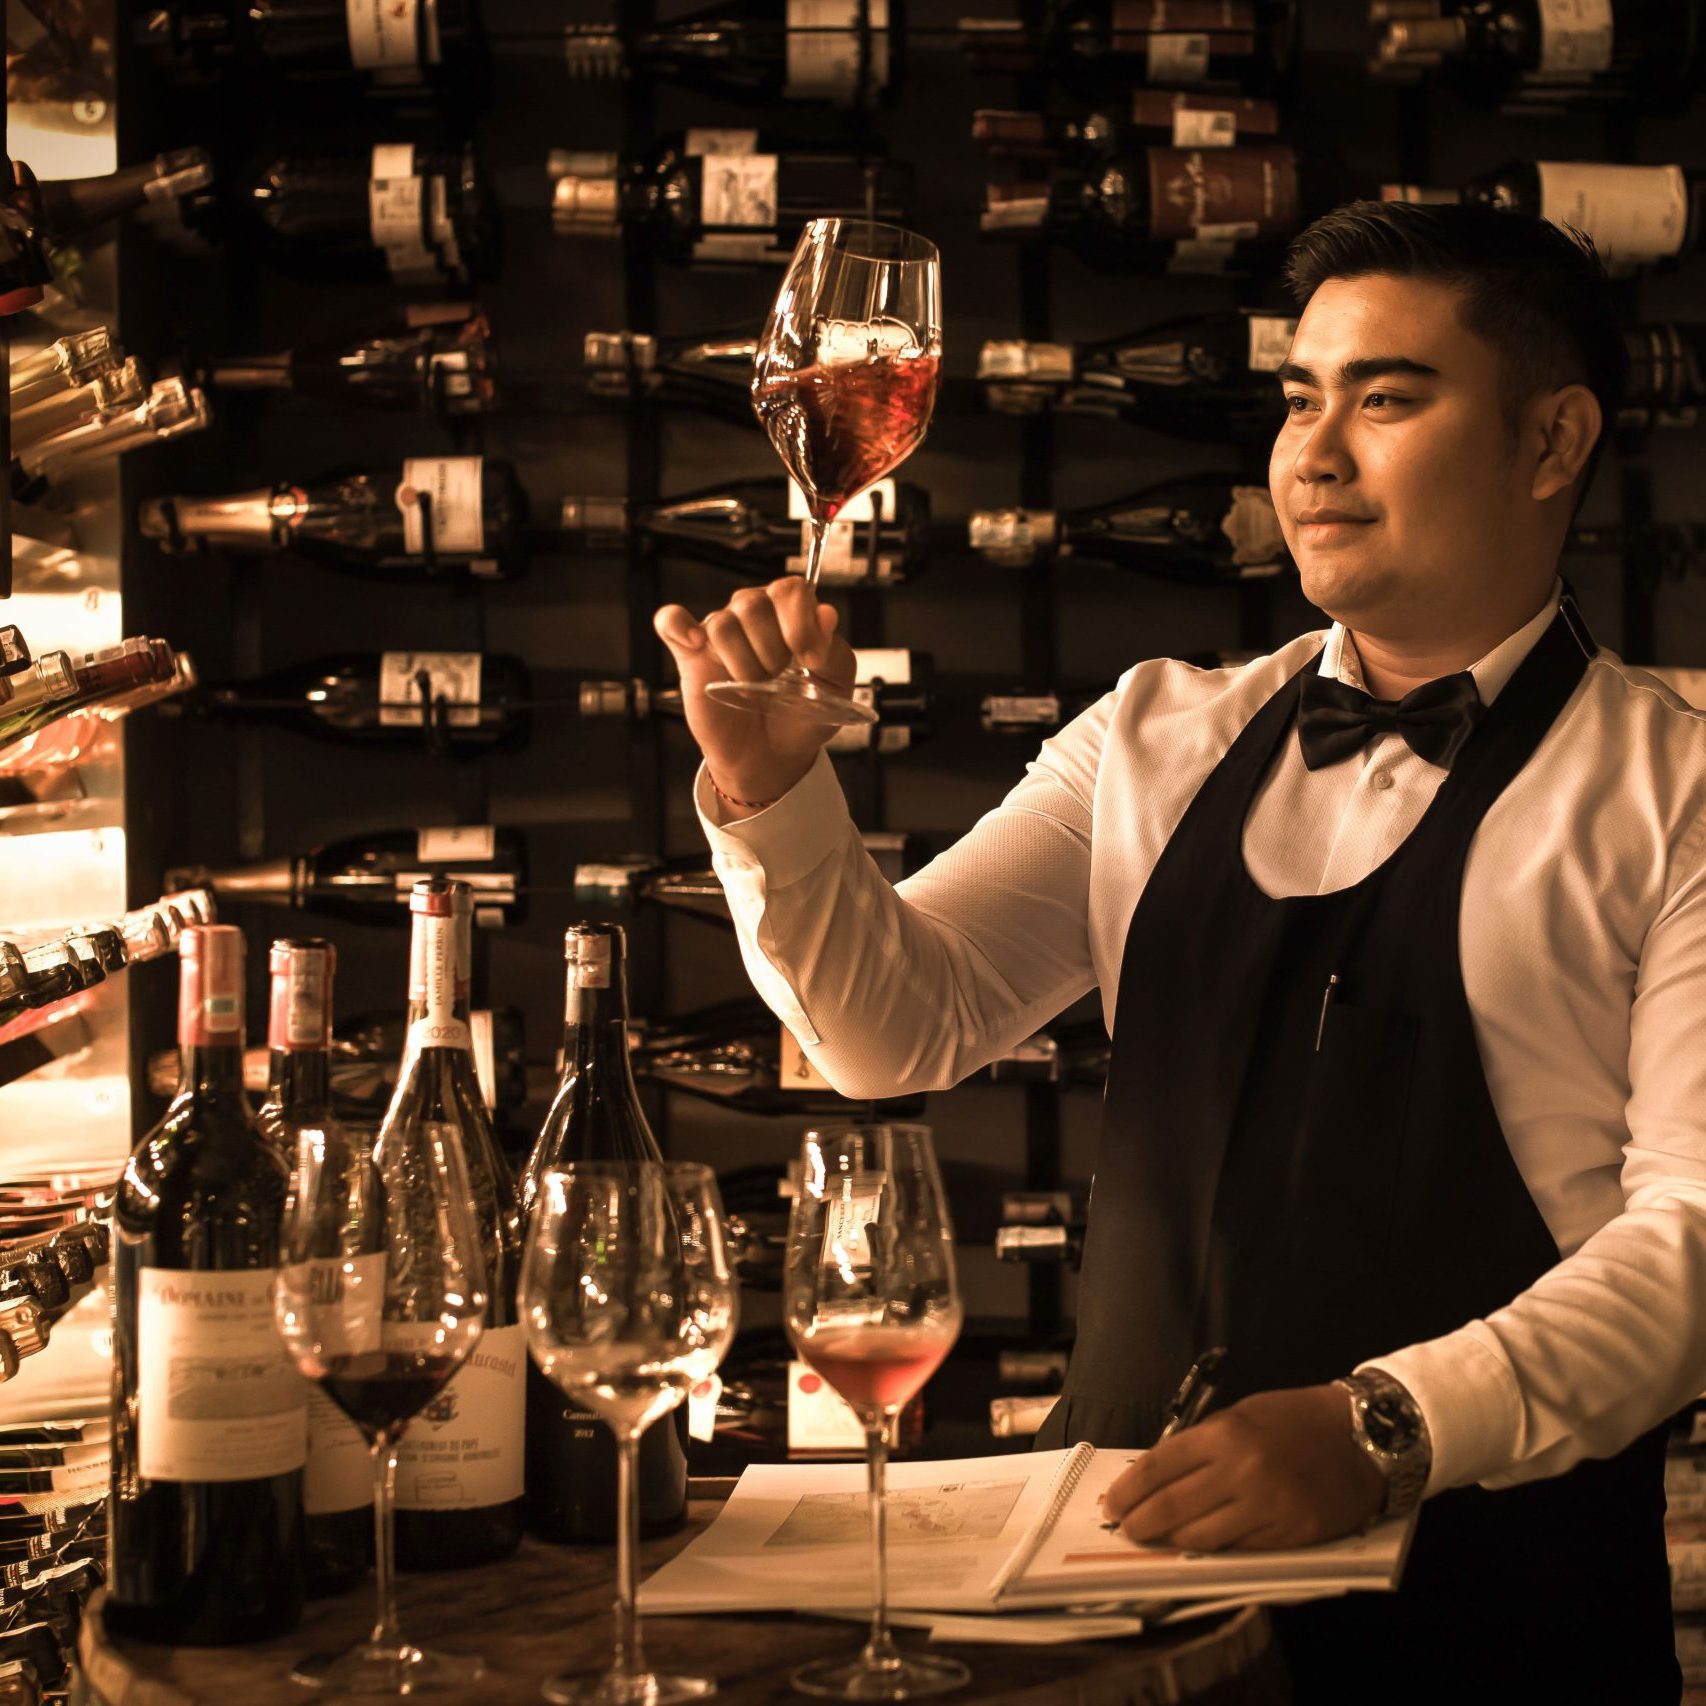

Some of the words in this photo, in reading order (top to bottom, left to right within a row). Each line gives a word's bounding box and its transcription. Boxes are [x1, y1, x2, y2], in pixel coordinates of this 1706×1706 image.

[436, 927, 444, 962] PERRIN
[435, 966, 443, 1006] FAMILLE
[422, 1026, 461, 1039] 2020
